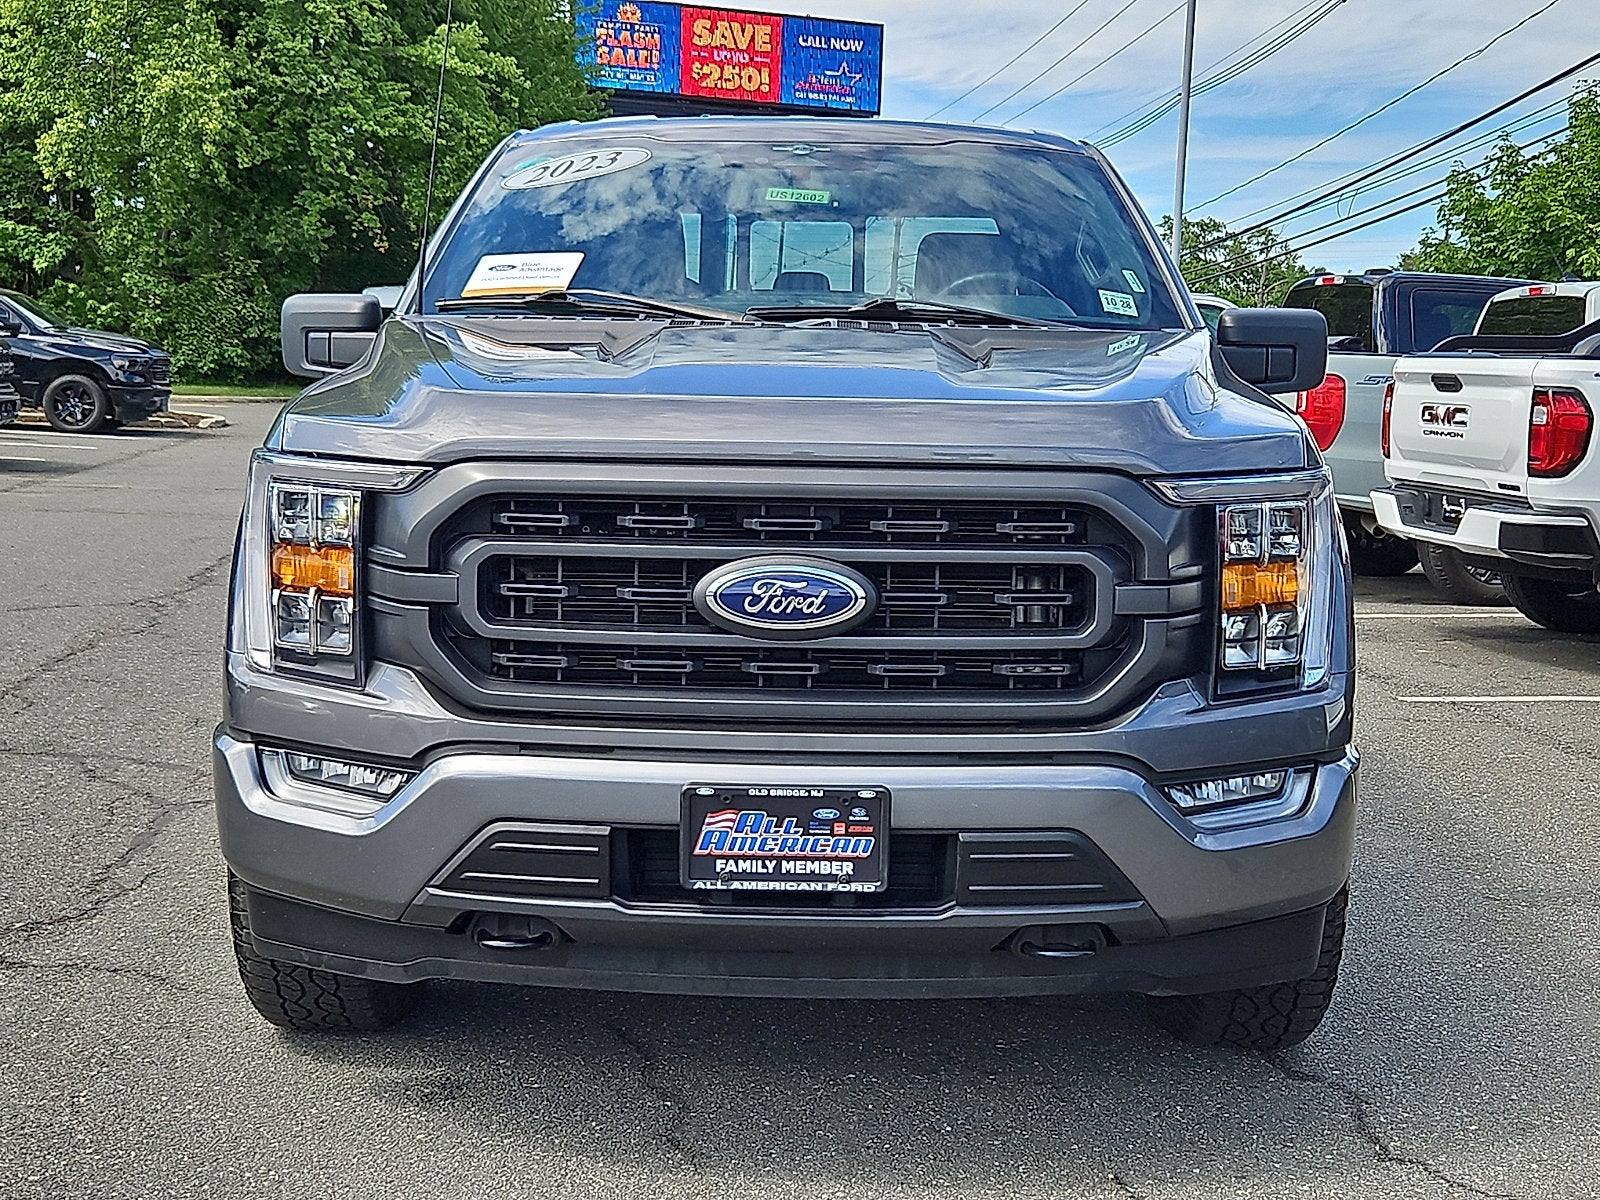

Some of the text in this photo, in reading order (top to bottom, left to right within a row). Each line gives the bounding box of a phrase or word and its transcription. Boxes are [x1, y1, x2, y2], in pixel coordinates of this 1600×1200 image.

[596, 28, 660, 50] FLASH
[692, 18, 772, 52] SAVE
[798, 34, 864, 52] CALL NOW
[692, 62, 770, 93] $250!
[522, 151, 623, 186] 2023
[1104, 297, 1132, 309] 10 28
[1421, 405, 1469, 427] GMC
[1423, 429, 1464, 439] CANYON
[744, 578, 829, 615] Ford
[748, 788, 768, 796] OLD
[810, 789, 824, 797] NJ
[715, 859, 854, 875] FAMILY MEMBER
[693, 881, 876, 892] ALL AMERICAN FORD
